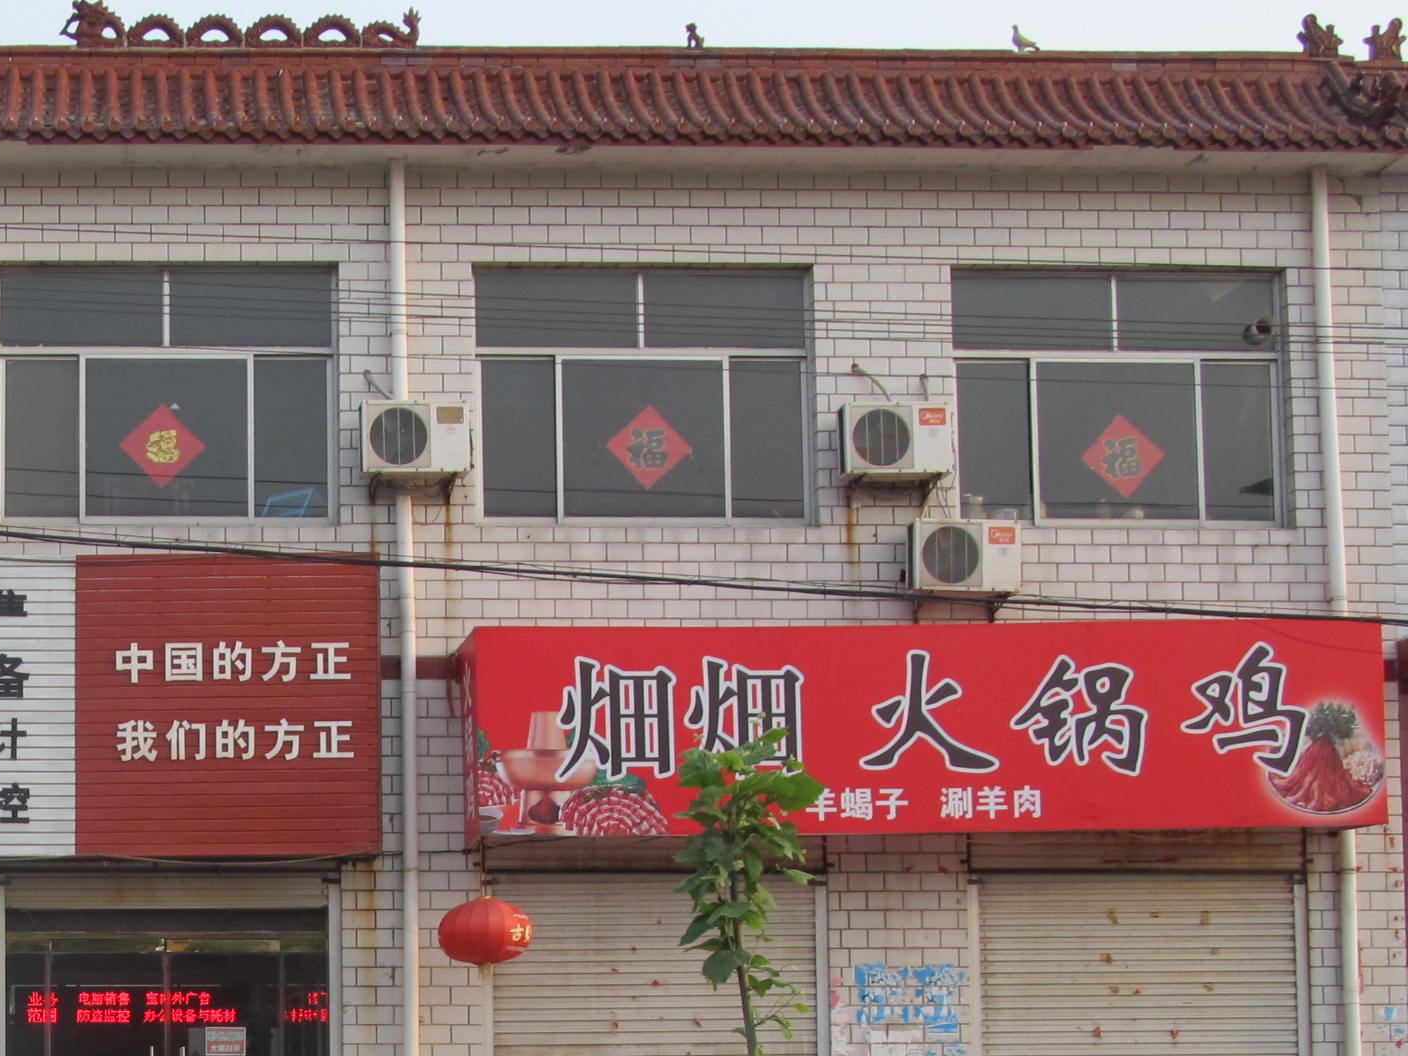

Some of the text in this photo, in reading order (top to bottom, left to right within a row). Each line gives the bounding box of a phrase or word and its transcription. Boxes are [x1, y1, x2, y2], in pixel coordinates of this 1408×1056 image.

[627, 427, 667, 469] 福
[1101, 436, 1144, 480] 福
[114, 641, 352, 684] 中国的方正
[116, 720, 355, 762] 我们的方正
[805, 785, 1042, 822] 羊蝎子 涮羊肉
[76, 1009, 130, 1023] 防盗监控
[143, 1008, 237, 1023] 办公设备与耗材
[79, 992, 130, 1006] 电脑销售
